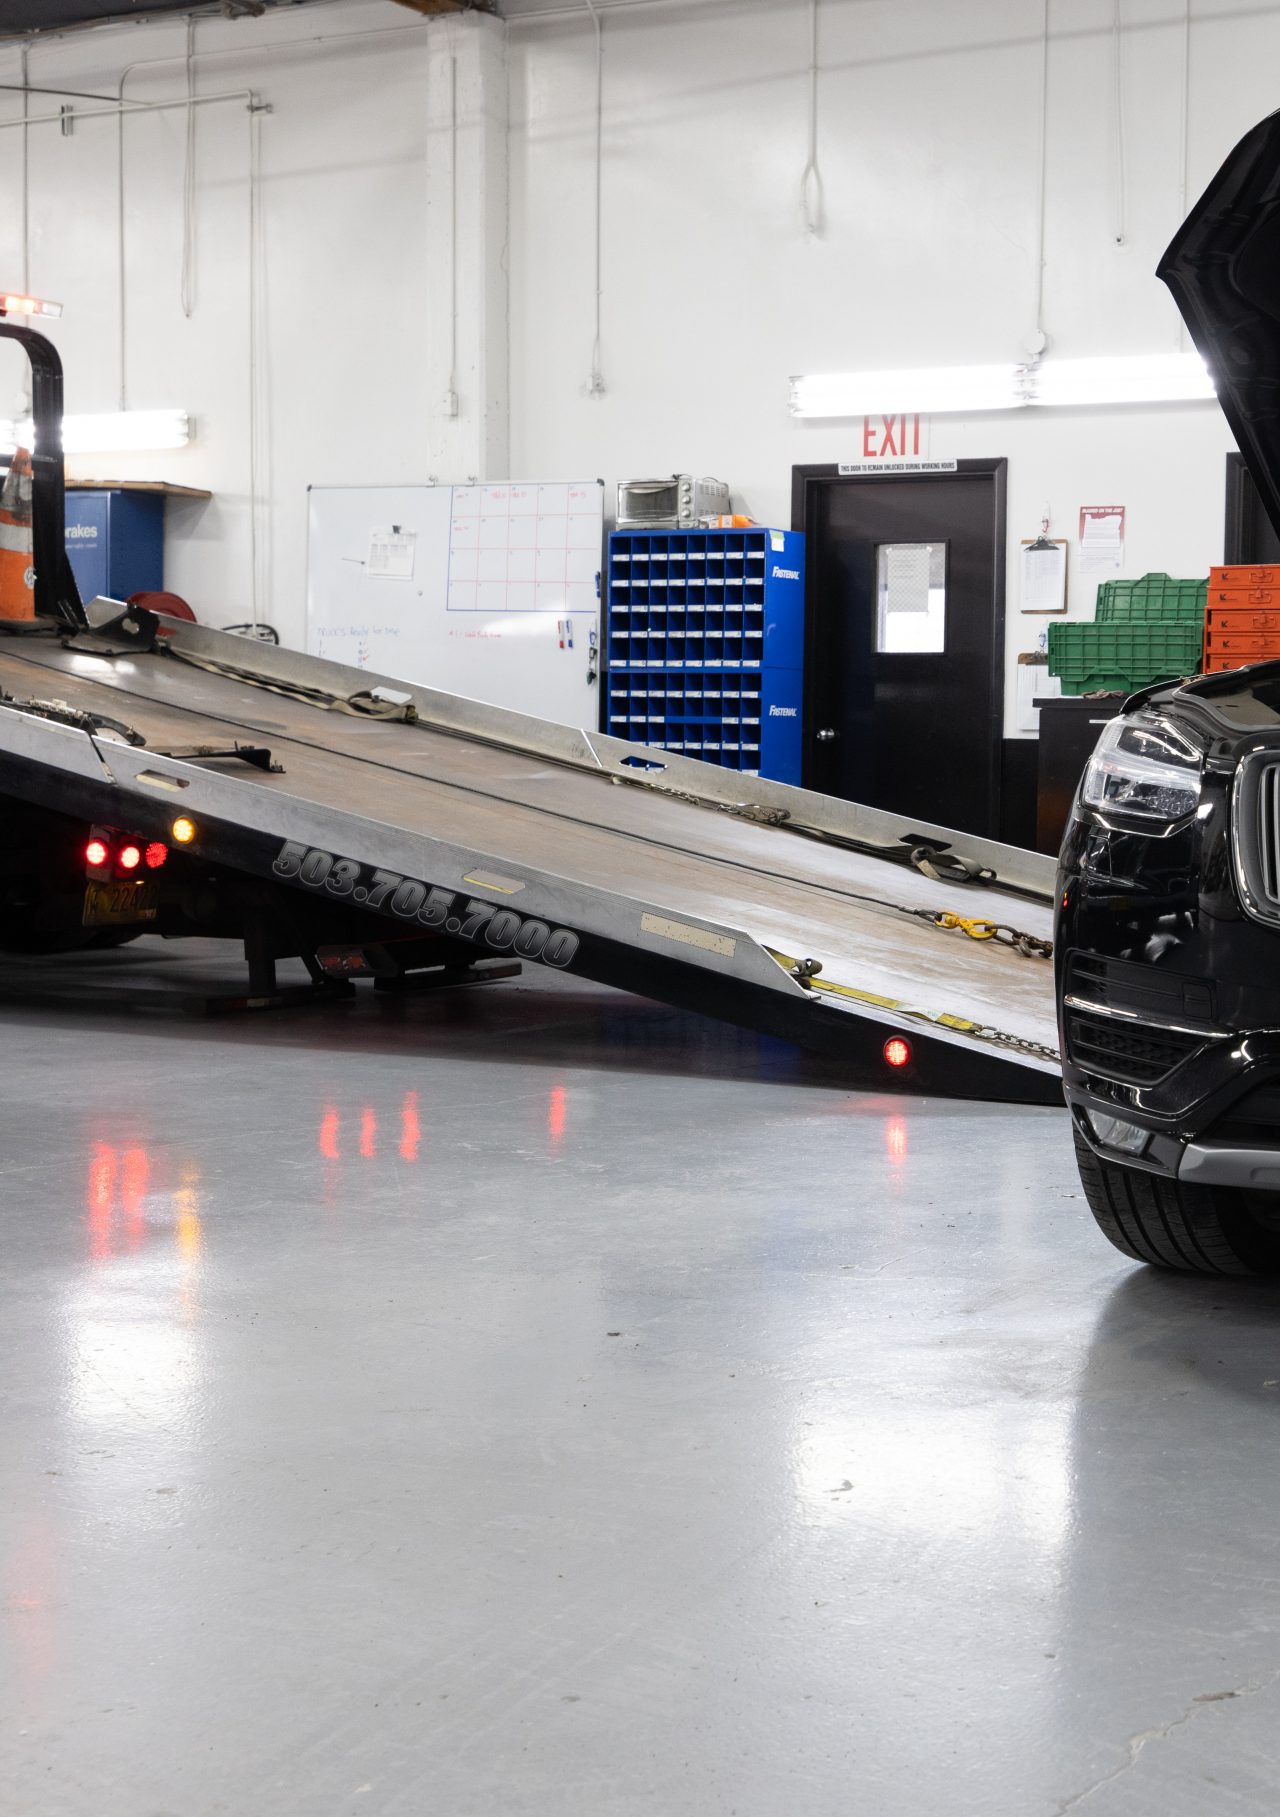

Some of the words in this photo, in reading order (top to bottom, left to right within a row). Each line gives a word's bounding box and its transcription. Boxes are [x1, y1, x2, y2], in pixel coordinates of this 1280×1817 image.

[863, 413, 920, 457] EXIT
[840, 465, 850, 473] THIS
[850, 464, 861, 472] DOOR
[884, 463, 905, 471] UNLOCKED
[905, 462, 920, 470] DURING
[921, 462, 940, 470] WORKING
[941, 461, 955, 469] HOURS
[272, 839, 580, 968] 503.705.7000
